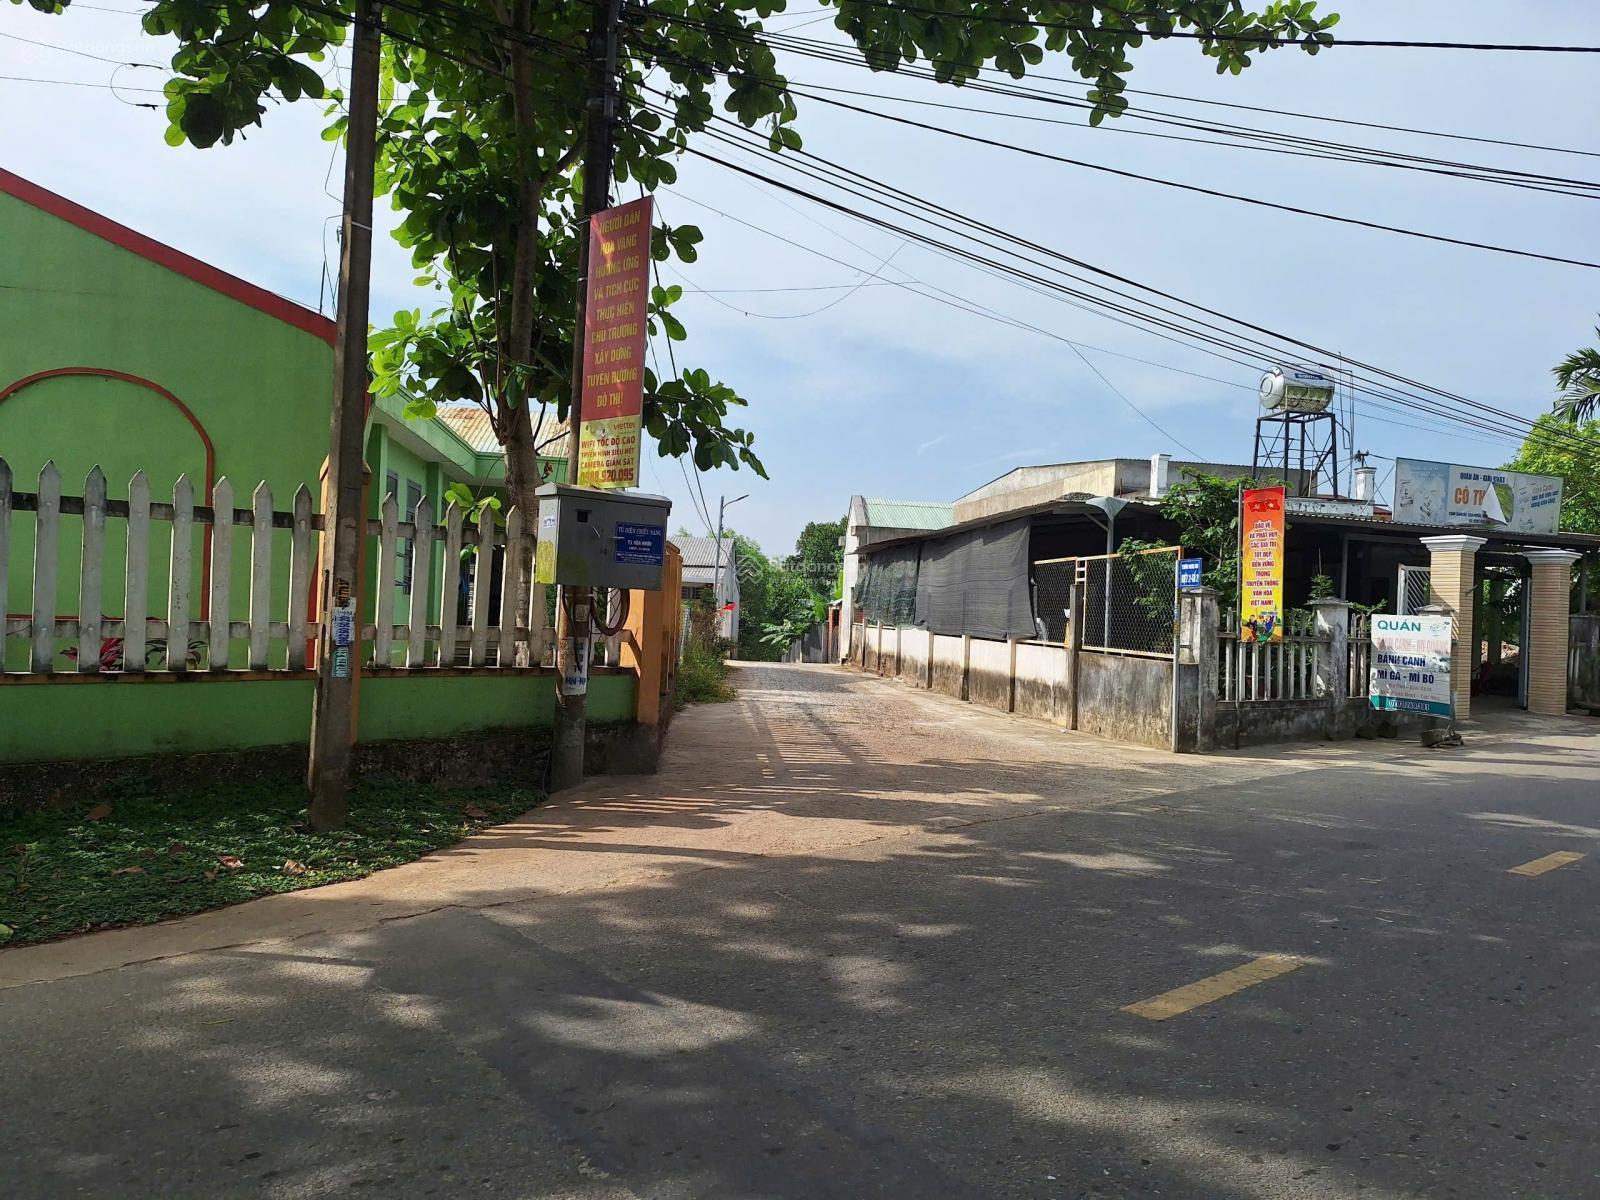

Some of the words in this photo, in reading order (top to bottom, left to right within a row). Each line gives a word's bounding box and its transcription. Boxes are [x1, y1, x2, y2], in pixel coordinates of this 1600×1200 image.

[596, 308, 615, 323] THỰC
[617, 300, 635, 318] HIỆN
[594, 349, 609, 365] XÂY
[611, 345, 632, 363] DỰNG
[581, 440, 596, 449] WIFI
[597, 436, 609, 447] TỐC
[611, 435, 620, 447] ĐỘ
[622, 435, 635, 445] CAO
[581, 460, 604, 470] CAMERA
[623, 456, 634, 466] SÁT
[1455, 485, 1469, 505] CÔ
[1377, 619, 1421, 632] QUÁN
[1377, 653, 1400, 664] BÁNH
[1402, 656, 1426, 667] CANH
